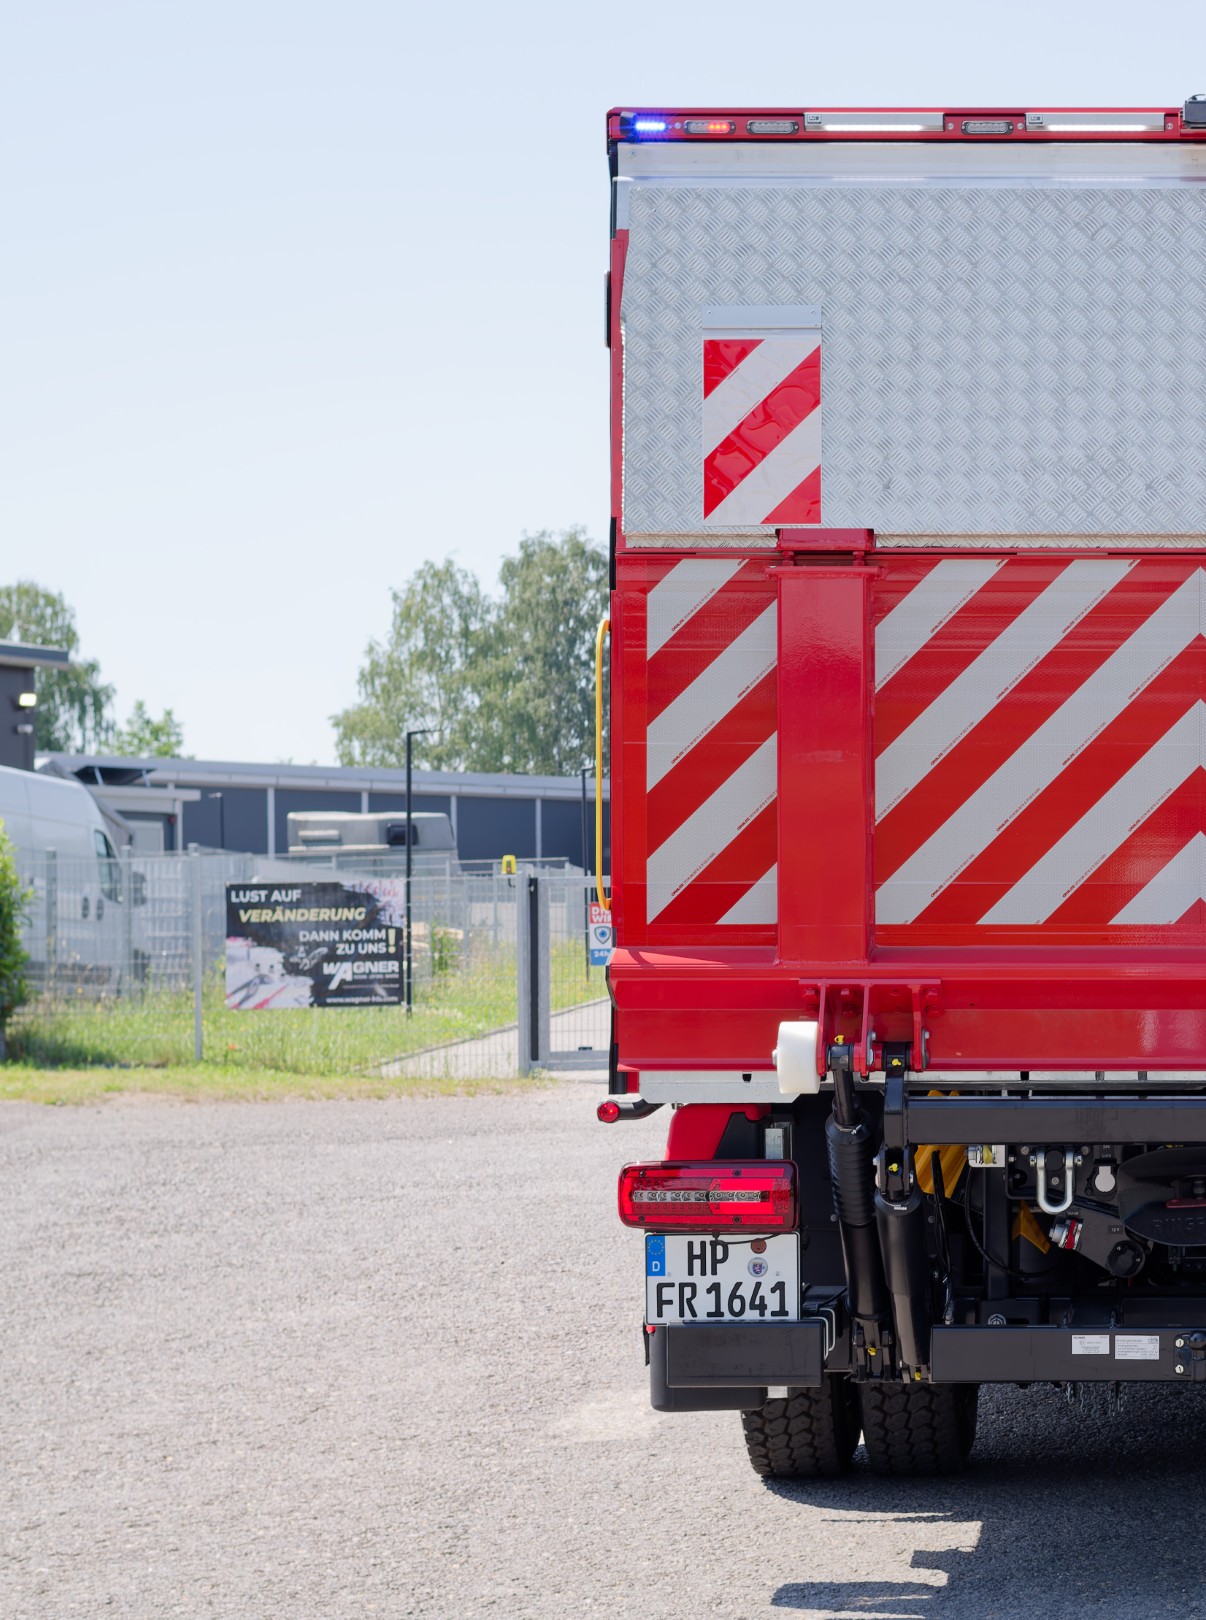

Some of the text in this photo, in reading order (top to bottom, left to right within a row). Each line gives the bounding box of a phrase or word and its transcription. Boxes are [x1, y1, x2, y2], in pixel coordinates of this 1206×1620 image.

[231, 889, 301, 903] LUST AUF
[239, 905, 366, 923] VERÄNDERUNG
[299, 929, 386, 941] DANN KOMM
[336, 944, 355, 955] ZU
[358, 943, 387, 955] UNS
[323, 960, 399, 991] WAGNER
[687, 1240, 729, 1277] HP
[652, 1261, 660, 1272] D
